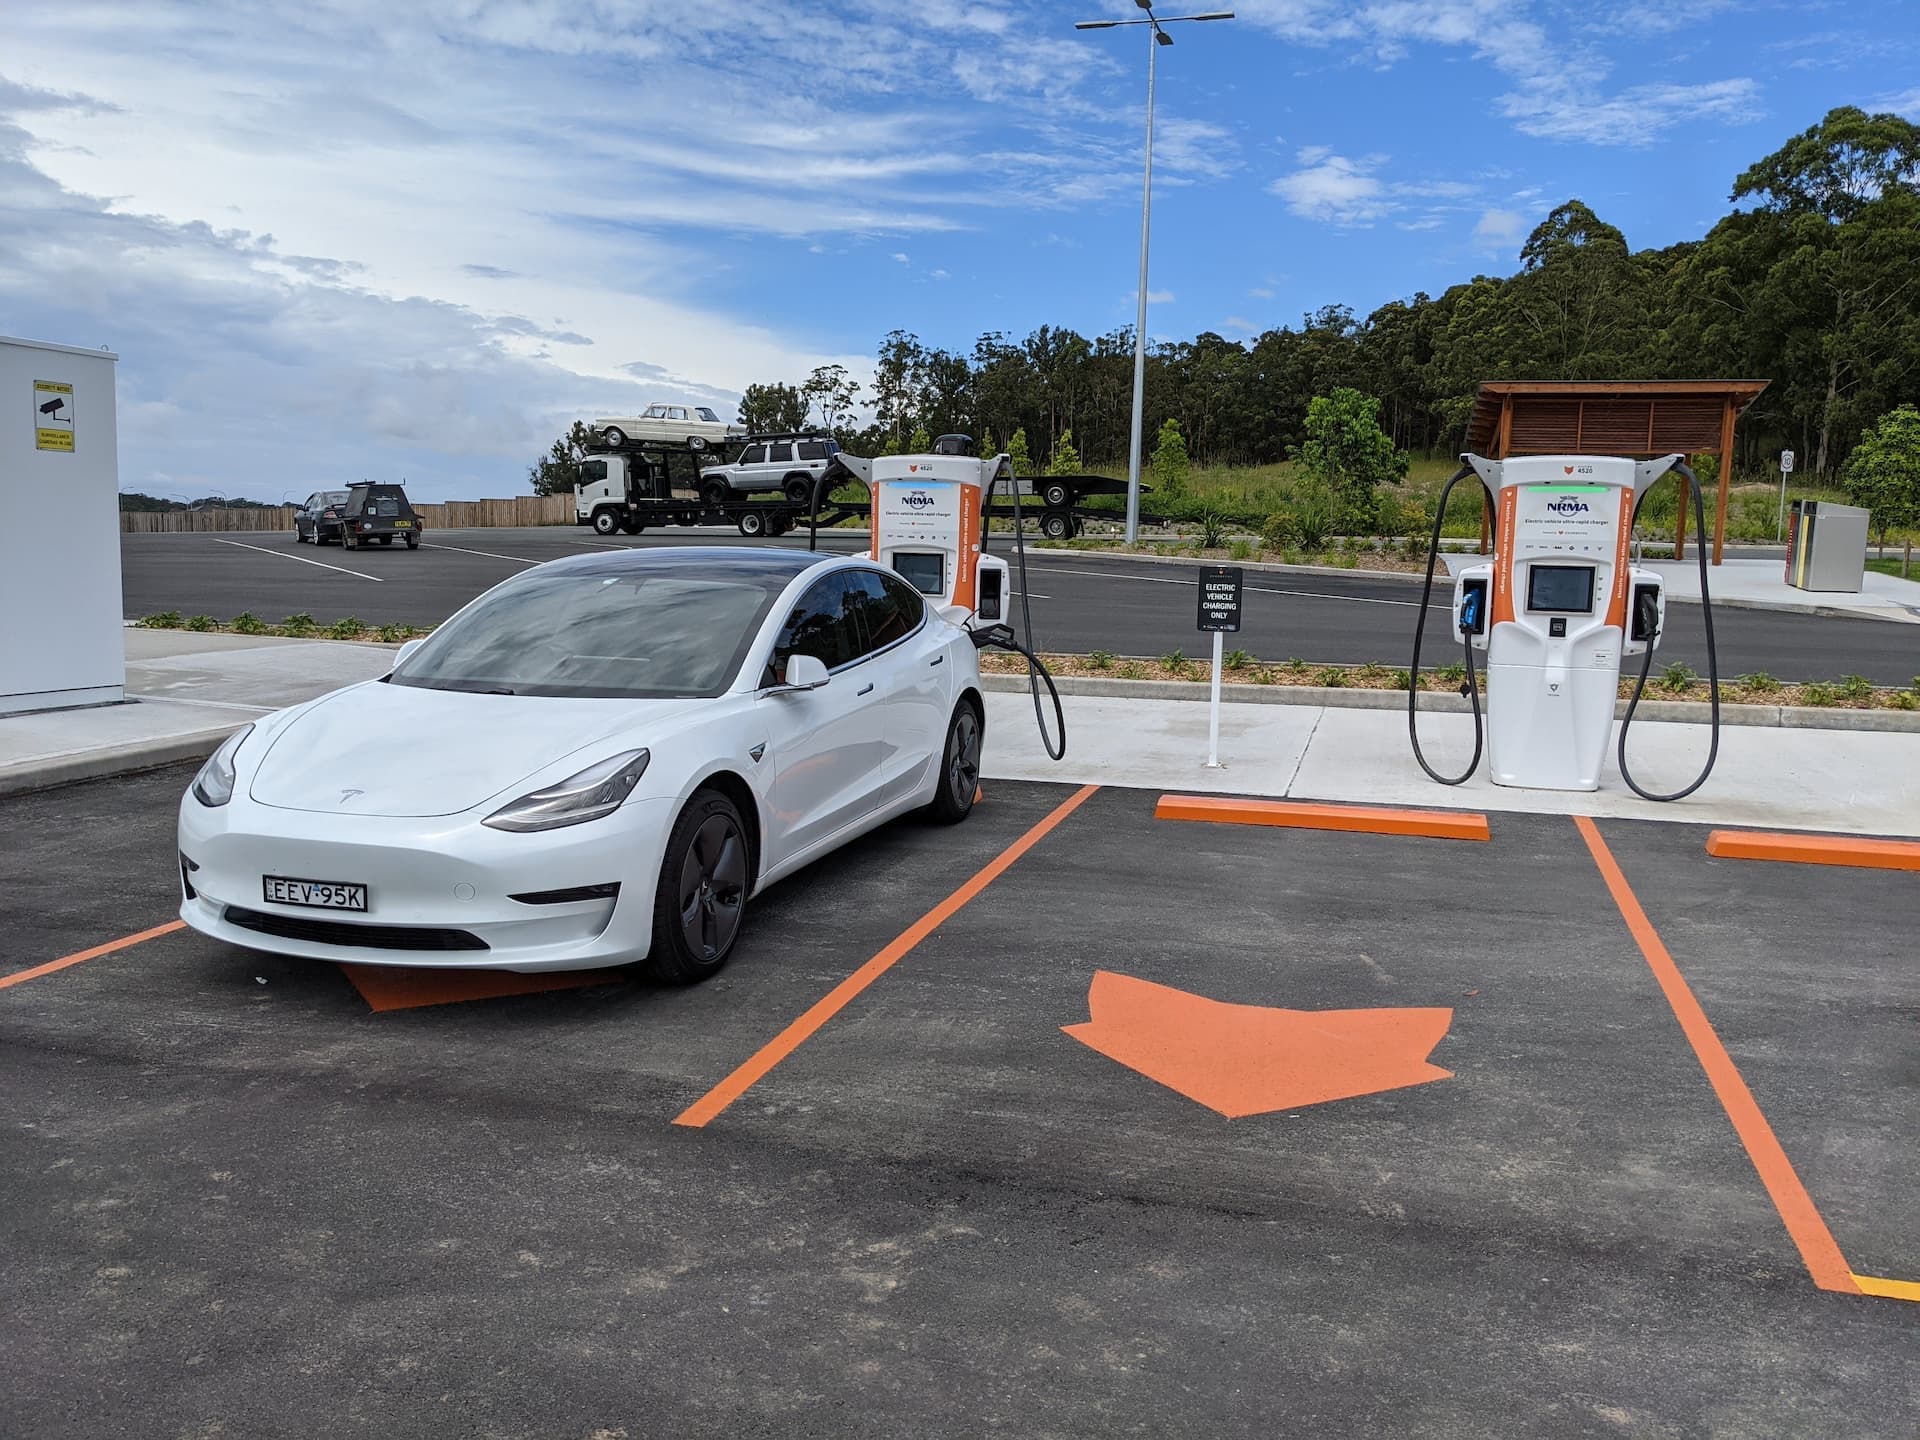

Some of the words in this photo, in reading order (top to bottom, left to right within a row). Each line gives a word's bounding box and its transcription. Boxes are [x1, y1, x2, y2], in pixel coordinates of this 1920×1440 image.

[902, 497, 934, 505] NRMA
[1547, 503, 1589, 512] NRMA
[1203, 602, 1236, 610] CHARGING
